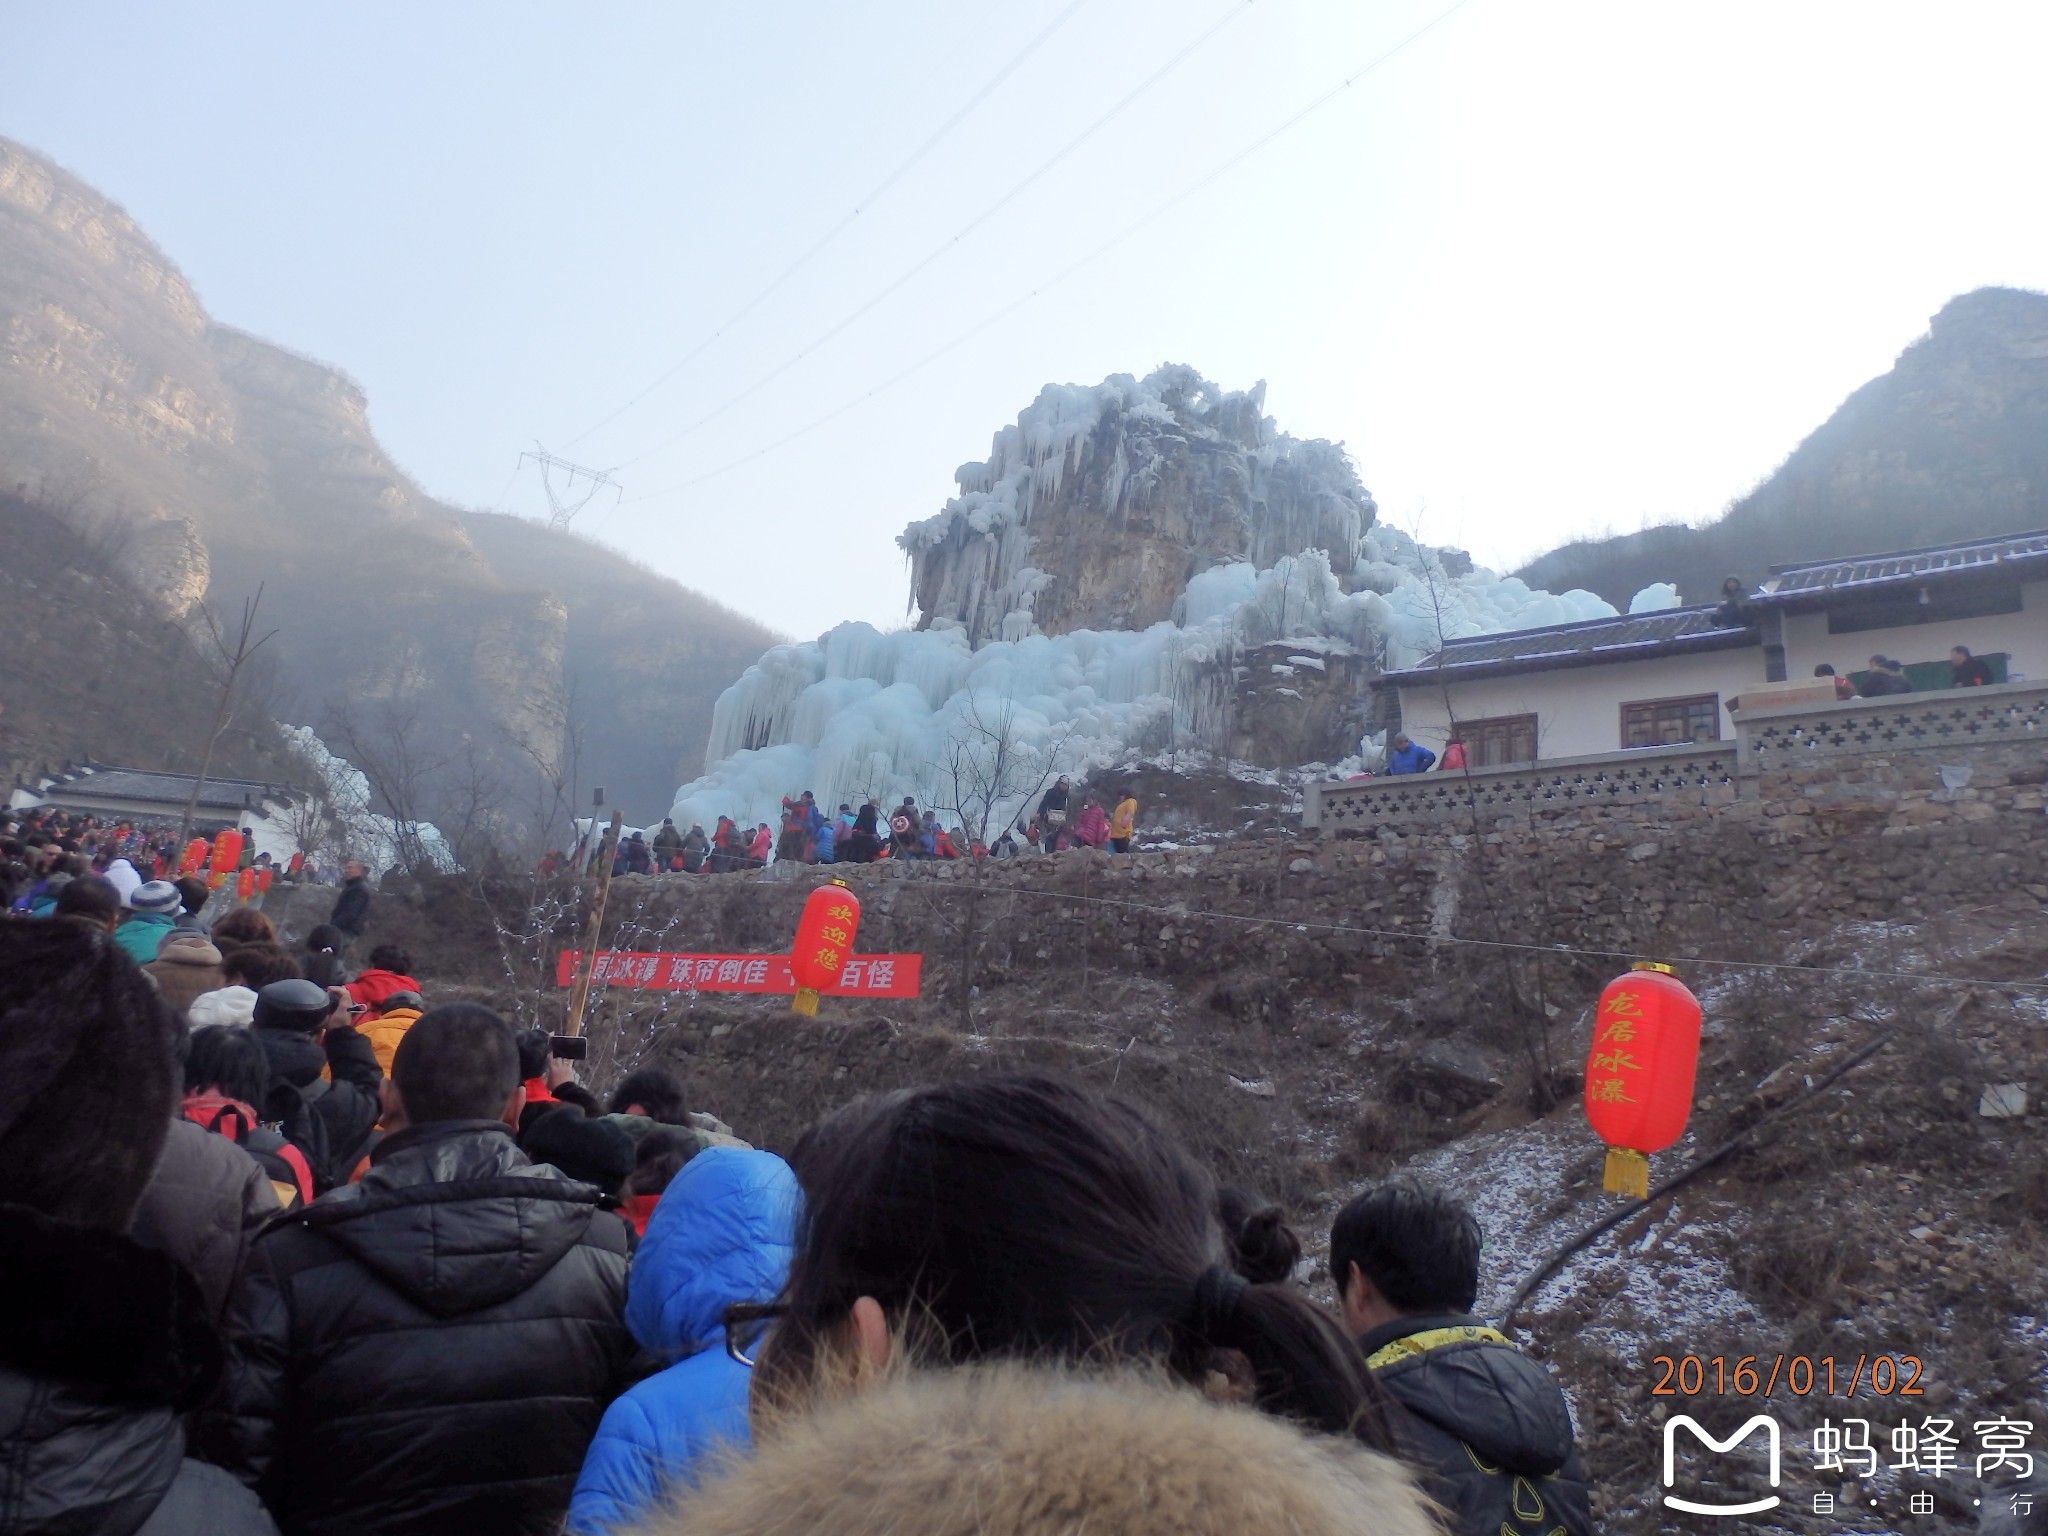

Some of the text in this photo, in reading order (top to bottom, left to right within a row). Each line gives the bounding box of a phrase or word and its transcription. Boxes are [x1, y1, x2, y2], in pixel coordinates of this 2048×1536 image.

[575, 955, 661, 983] 居冰瀑
[813, 904, 853, 971] 欢迎您
[1591, 991, 1644, 1104] 龙居冰瀑
